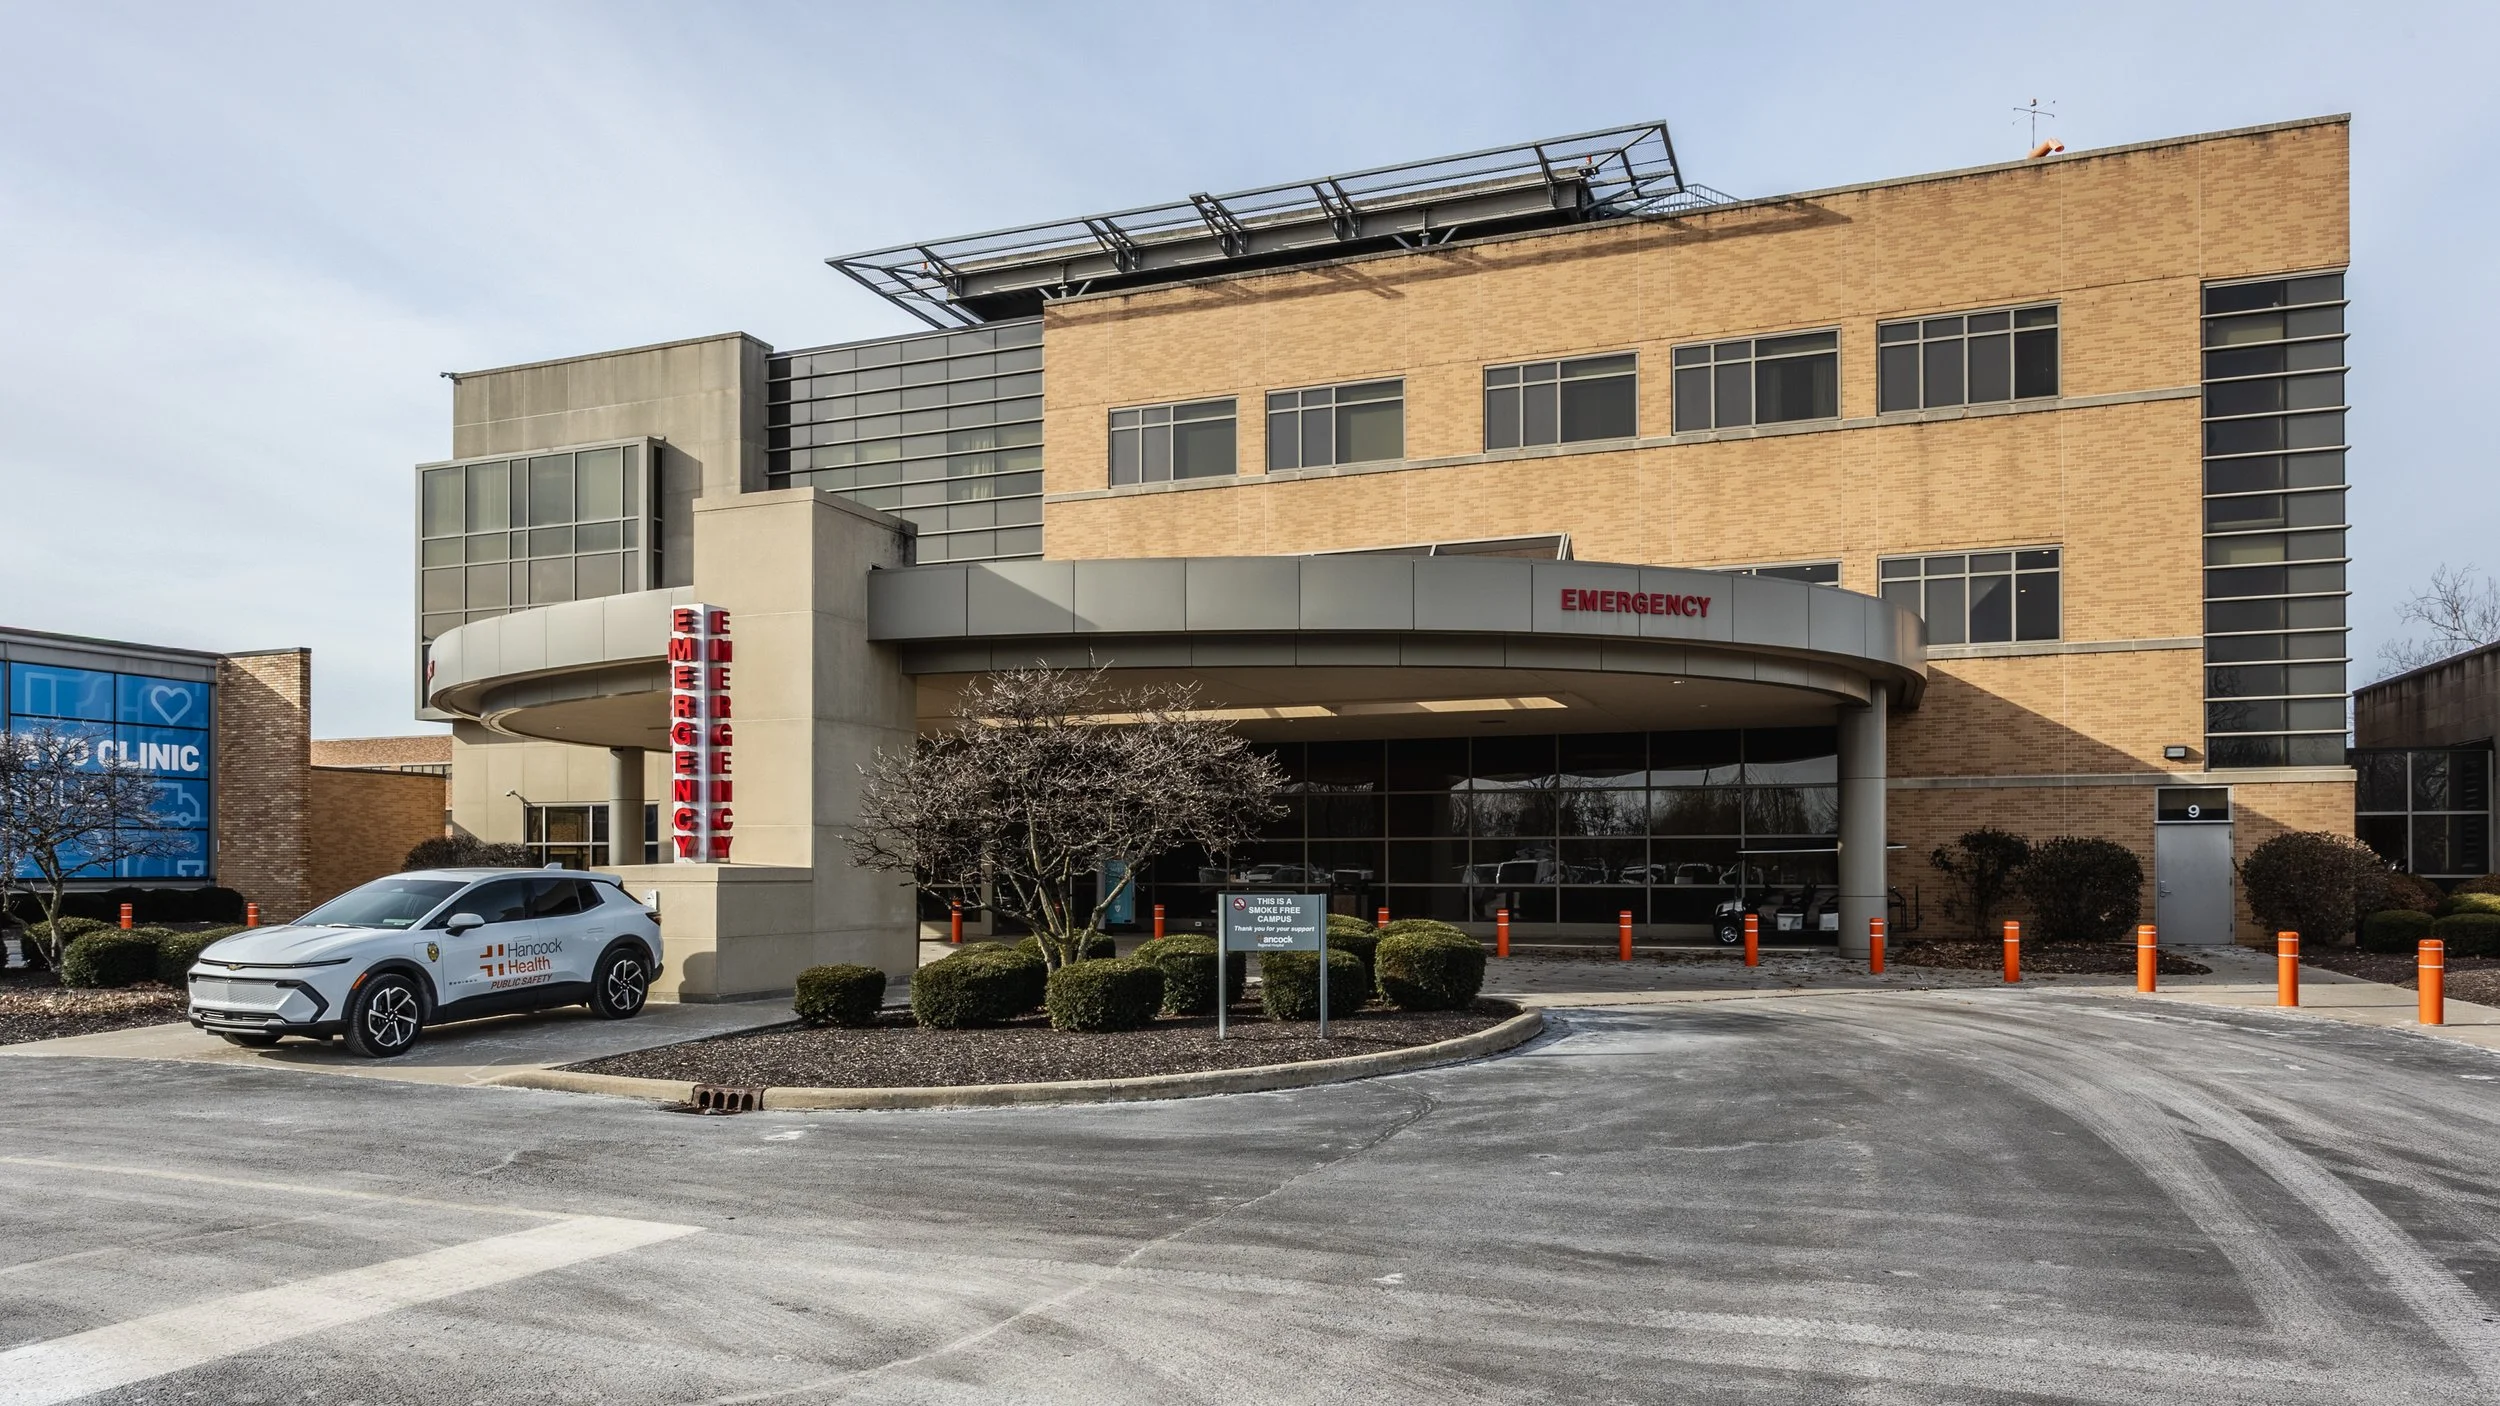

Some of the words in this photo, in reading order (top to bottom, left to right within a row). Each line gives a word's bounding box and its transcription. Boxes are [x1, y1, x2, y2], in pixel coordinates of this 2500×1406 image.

[1561, 589, 1711, 617] EMERGENCY
[671, 608, 699, 858] EMERGENCY
[710, 610, 733, 858] EMERGENCY
[97, 740, 200, 771] CLINIC
[2188, 805, 2200, 818] 9
[1248, 906, 1278, 914] SMOKE
[1279, 906, 1301, 914] FREE
[1257, 915, 1292, 923] CAMPUS
[507, 938, 563, 958] Hancock
[508, 956, 551, 975] Health
[490, 978, 521, 990] PUBLIC
[521, 973, 553, 985] SAFETY
